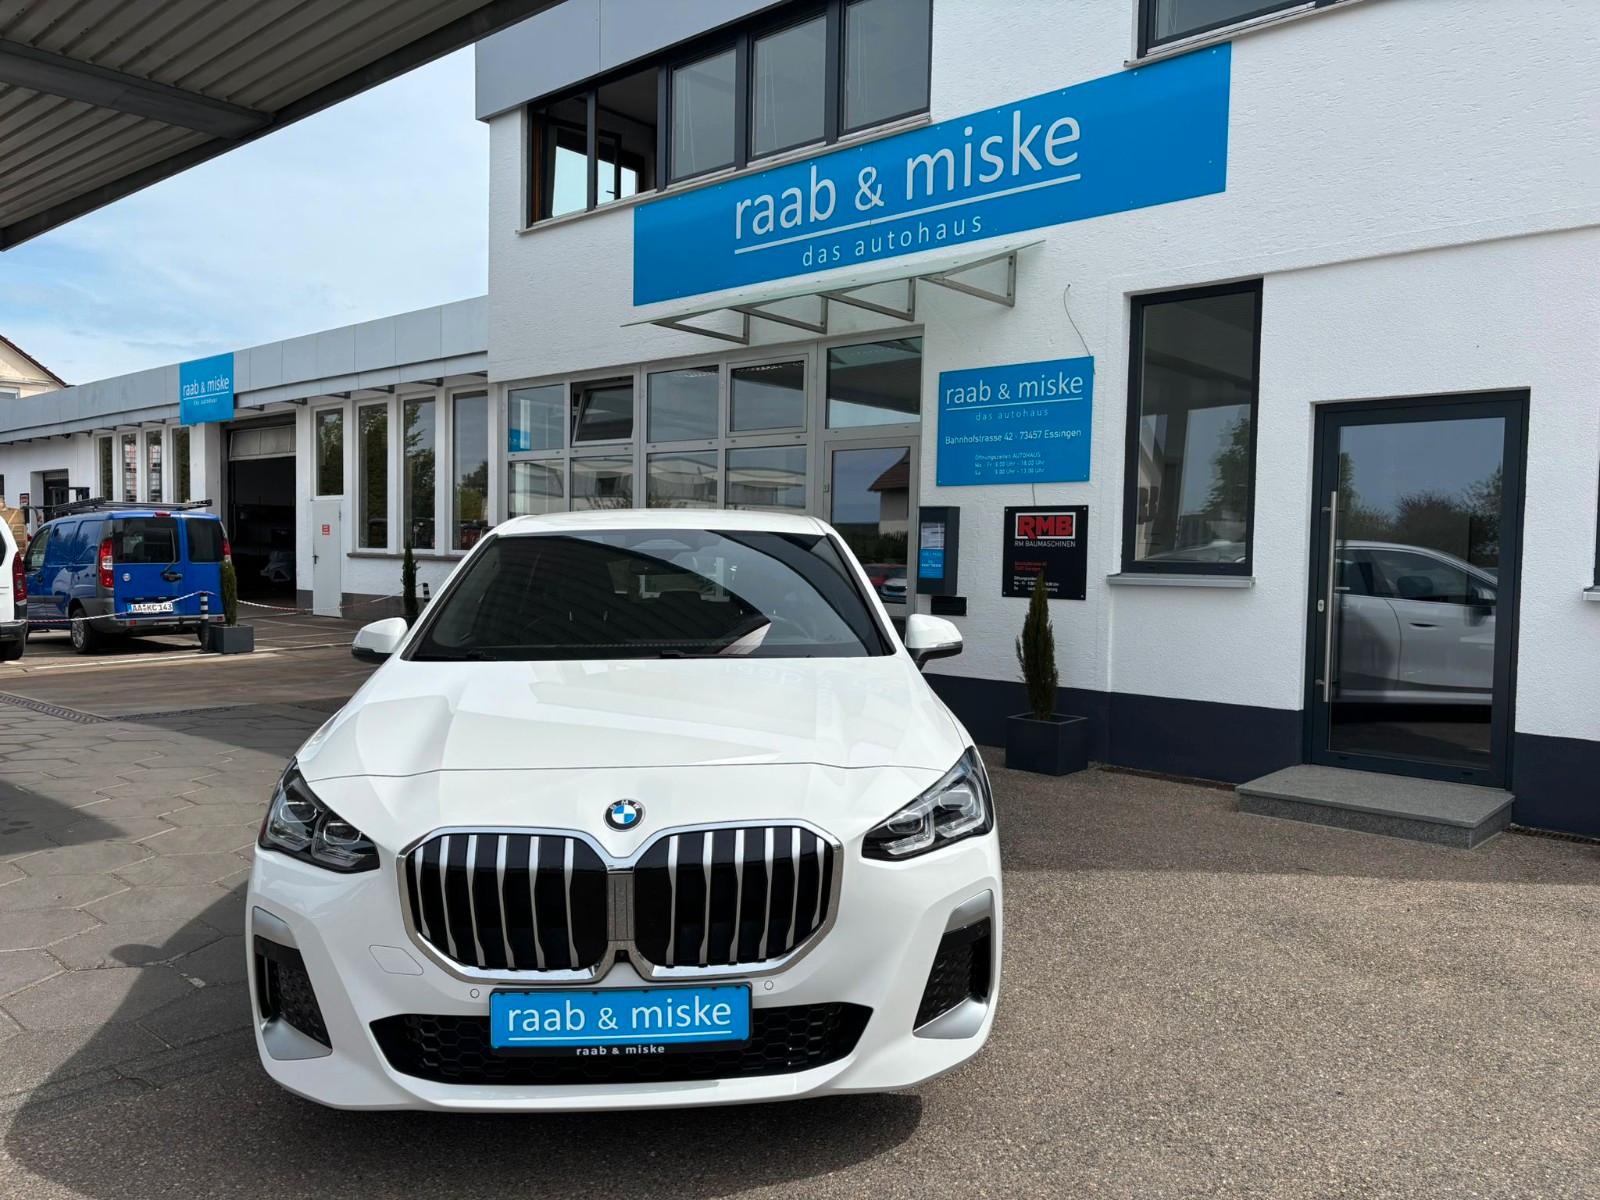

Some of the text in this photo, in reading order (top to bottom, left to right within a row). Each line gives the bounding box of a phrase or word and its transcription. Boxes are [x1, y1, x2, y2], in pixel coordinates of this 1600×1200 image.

[735, 110, 1081, 240] raab & miske
[803, 215, 982, 267] das autohaus
[183, 374, 230, 397] raab & miske
[946, 371, 1083, 405] raab & miske
[975, 408, 1049, 421] das autohaus
[1003, 432, 1013, 441] 42
[1020, 431, 1042, 440] 73457
[1044, 429, 1082, 440] Essingen
[1018, 515, 1073, 540] RMB
[1025, 540, 1076, 548] BAUMASCHINEN
[508, 995, 732, 1032] raab & miske
[576, 1044, 665, 1056] raab & miske
